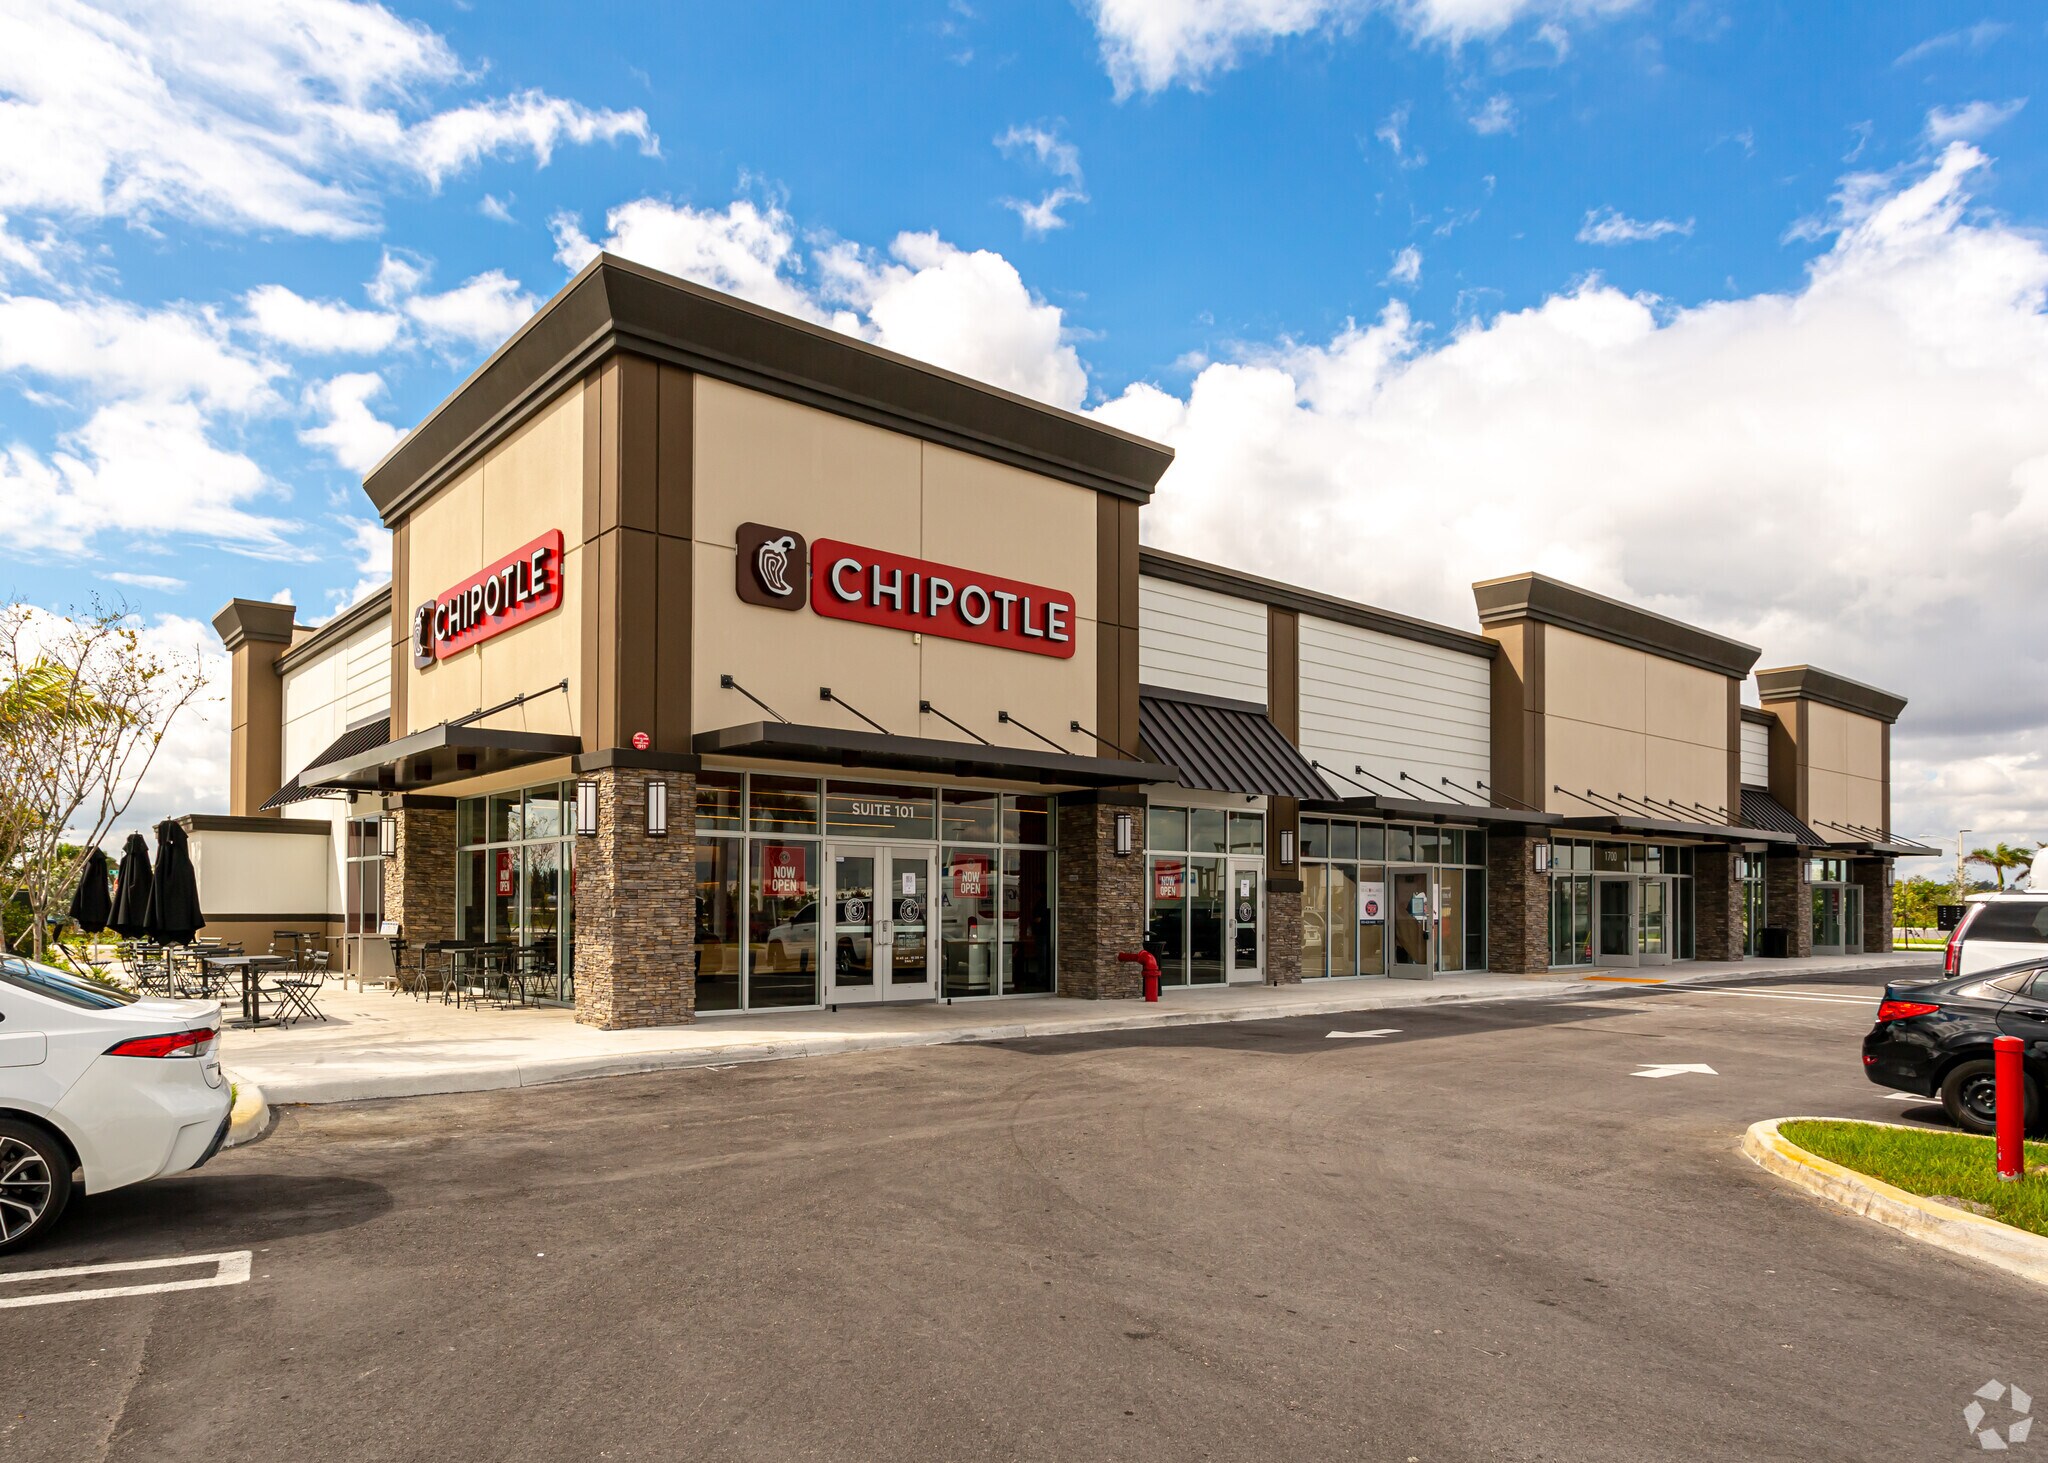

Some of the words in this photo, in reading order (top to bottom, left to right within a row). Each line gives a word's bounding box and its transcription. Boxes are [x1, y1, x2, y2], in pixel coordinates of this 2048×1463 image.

[434, 547, 547, 641] CHIPOTLE
[831, 557, 1069, 642] CHIPOTLE
[852, 802, 891, 817] SUITE
[894, 805, 914, 819] 101
[773, 865, 796, 879] NOW
[962, 871, 980, 883] NOW
[500, 880, 510, 892] OPEN
[772, 878, 797, 892] OPEN
[1160, 875, 1176, 886] NOW
[960, 882, 981, 894] OPEN
[1160, 886, 1176, 897] OPEN
